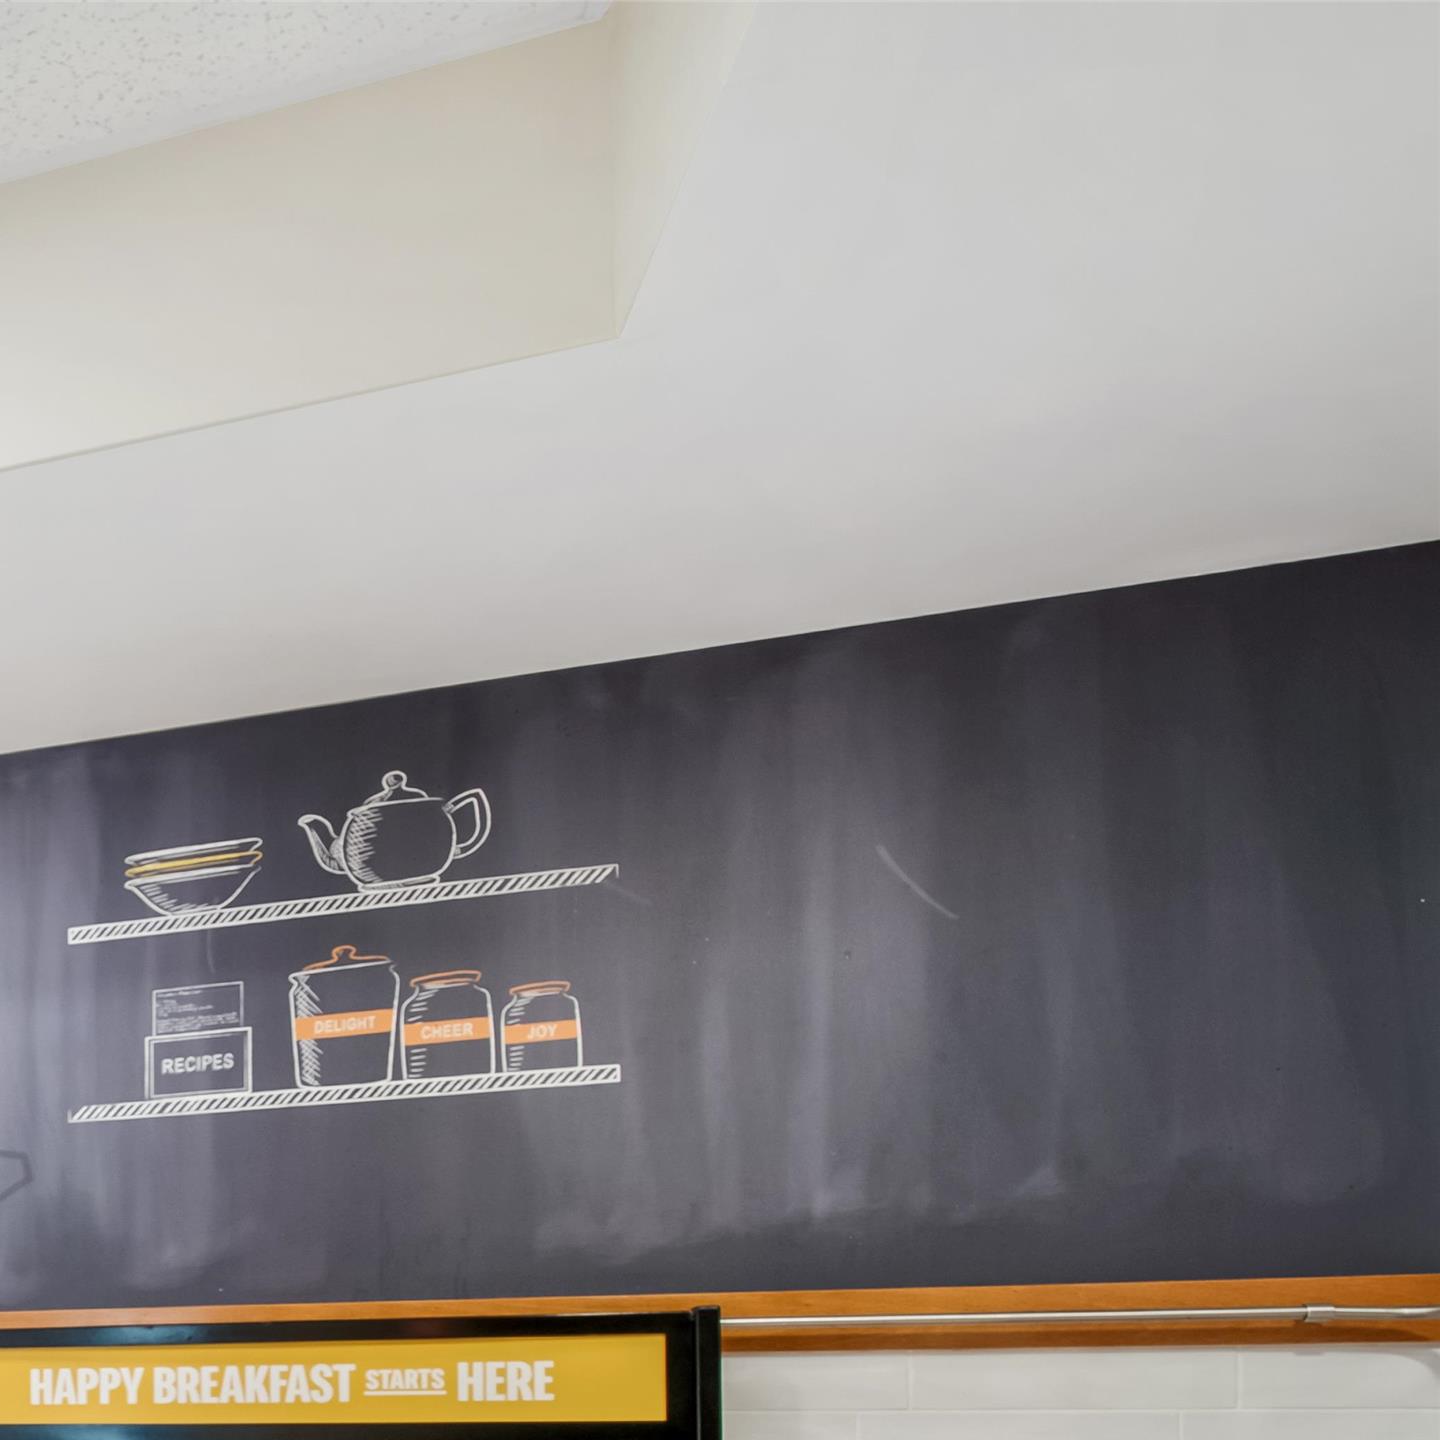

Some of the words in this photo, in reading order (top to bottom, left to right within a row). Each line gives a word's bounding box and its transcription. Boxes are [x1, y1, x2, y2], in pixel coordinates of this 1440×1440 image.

[313, 1015, 377, 1034] DELIGHT
[421, 1022, 474, 1040] CHEER
[527, 1023, 558, 1041] JOY
[161, 1052, 235, 1075] RECIPES
[29, 1366, 145, 1406] HAPPY
[152, 1363, 357, 1405] BREAKFAST
[364, 1367, 447, 1392] STARTS
[456, 1360, 555, 1402] HERE
